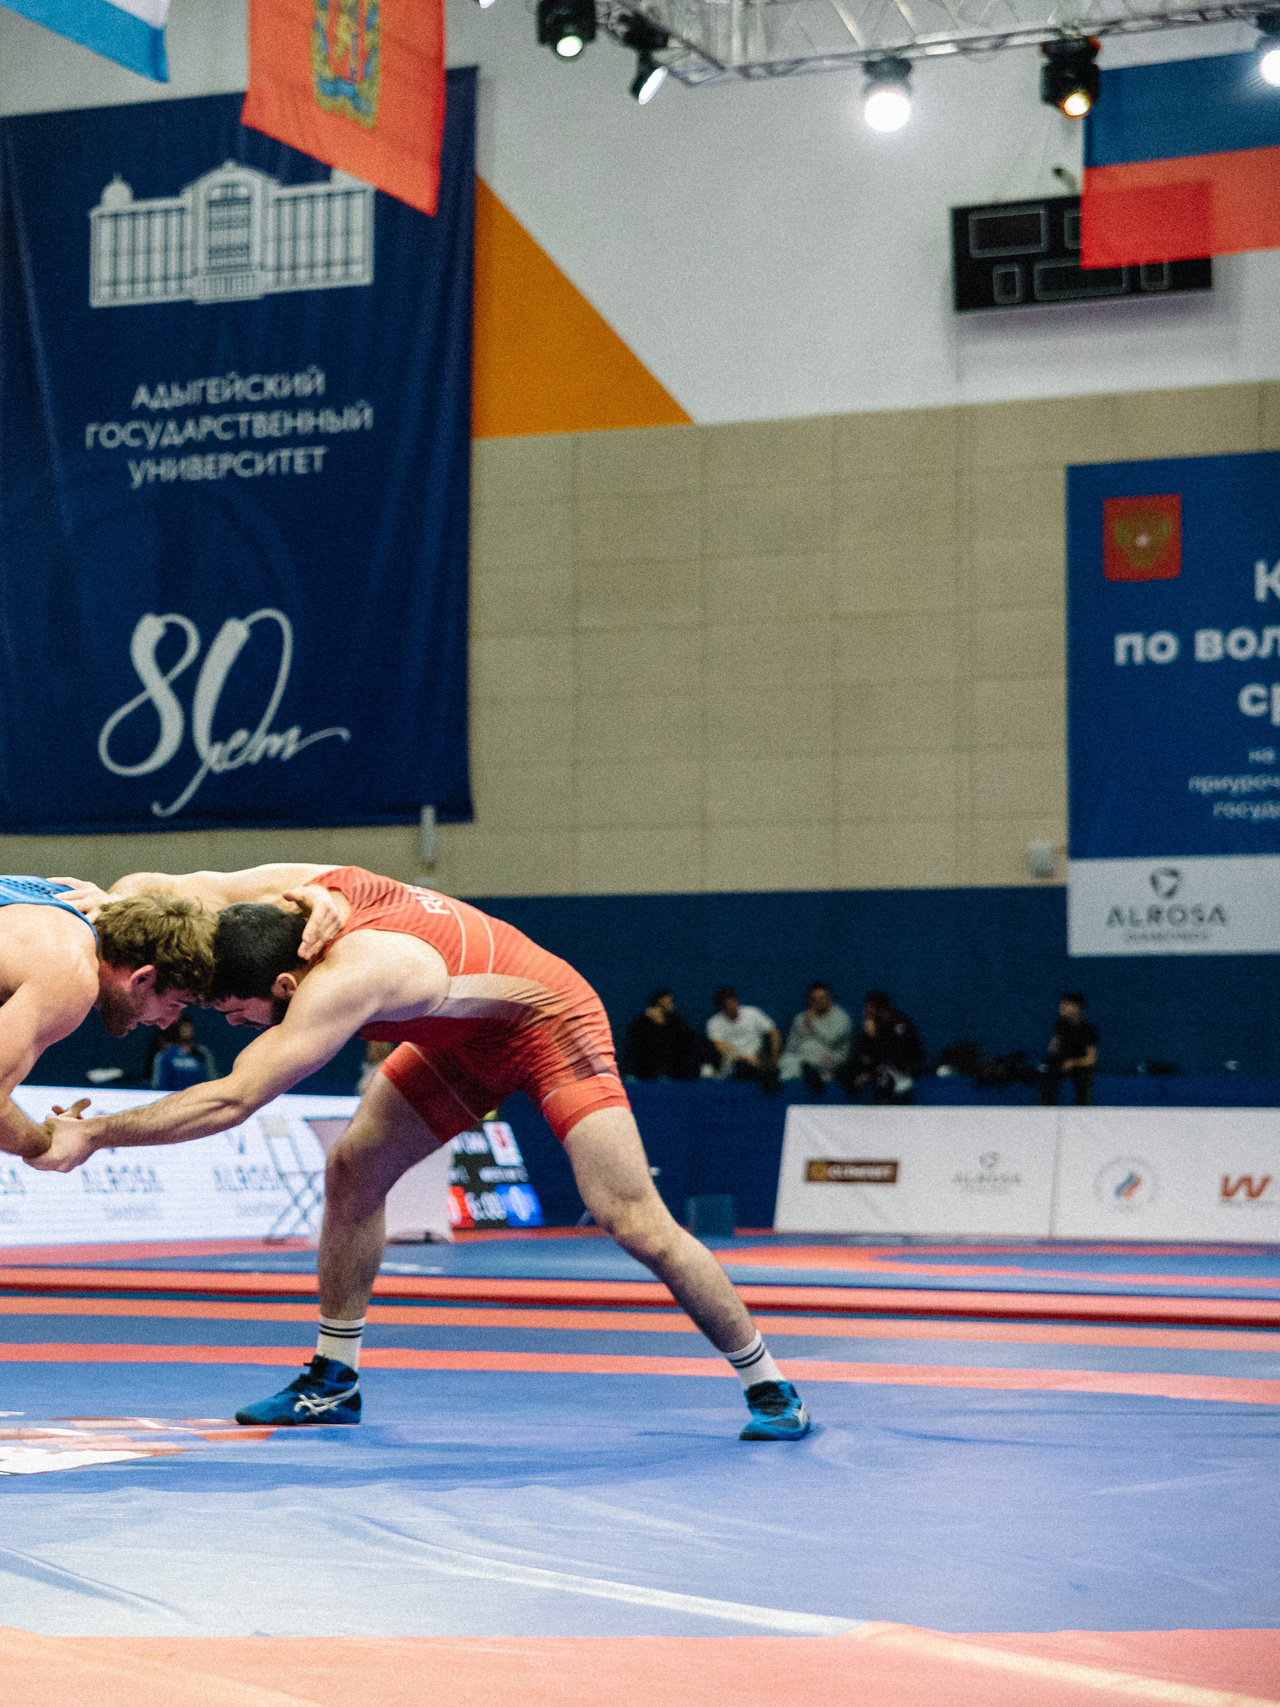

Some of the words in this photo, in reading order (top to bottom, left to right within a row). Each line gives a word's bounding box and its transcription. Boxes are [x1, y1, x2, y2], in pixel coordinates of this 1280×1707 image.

[131, 364, 327, 412] АДЫГЕЙСКИЙ
[85, 400, 374, 450] ГОСУДАРСТВЕННЫЙ
[128, 445, 328, 489] УНИВЕРСИТЕТ
[98, 608, 294, 778] 80
[1106, 903, 1228, 928] ALROSA
